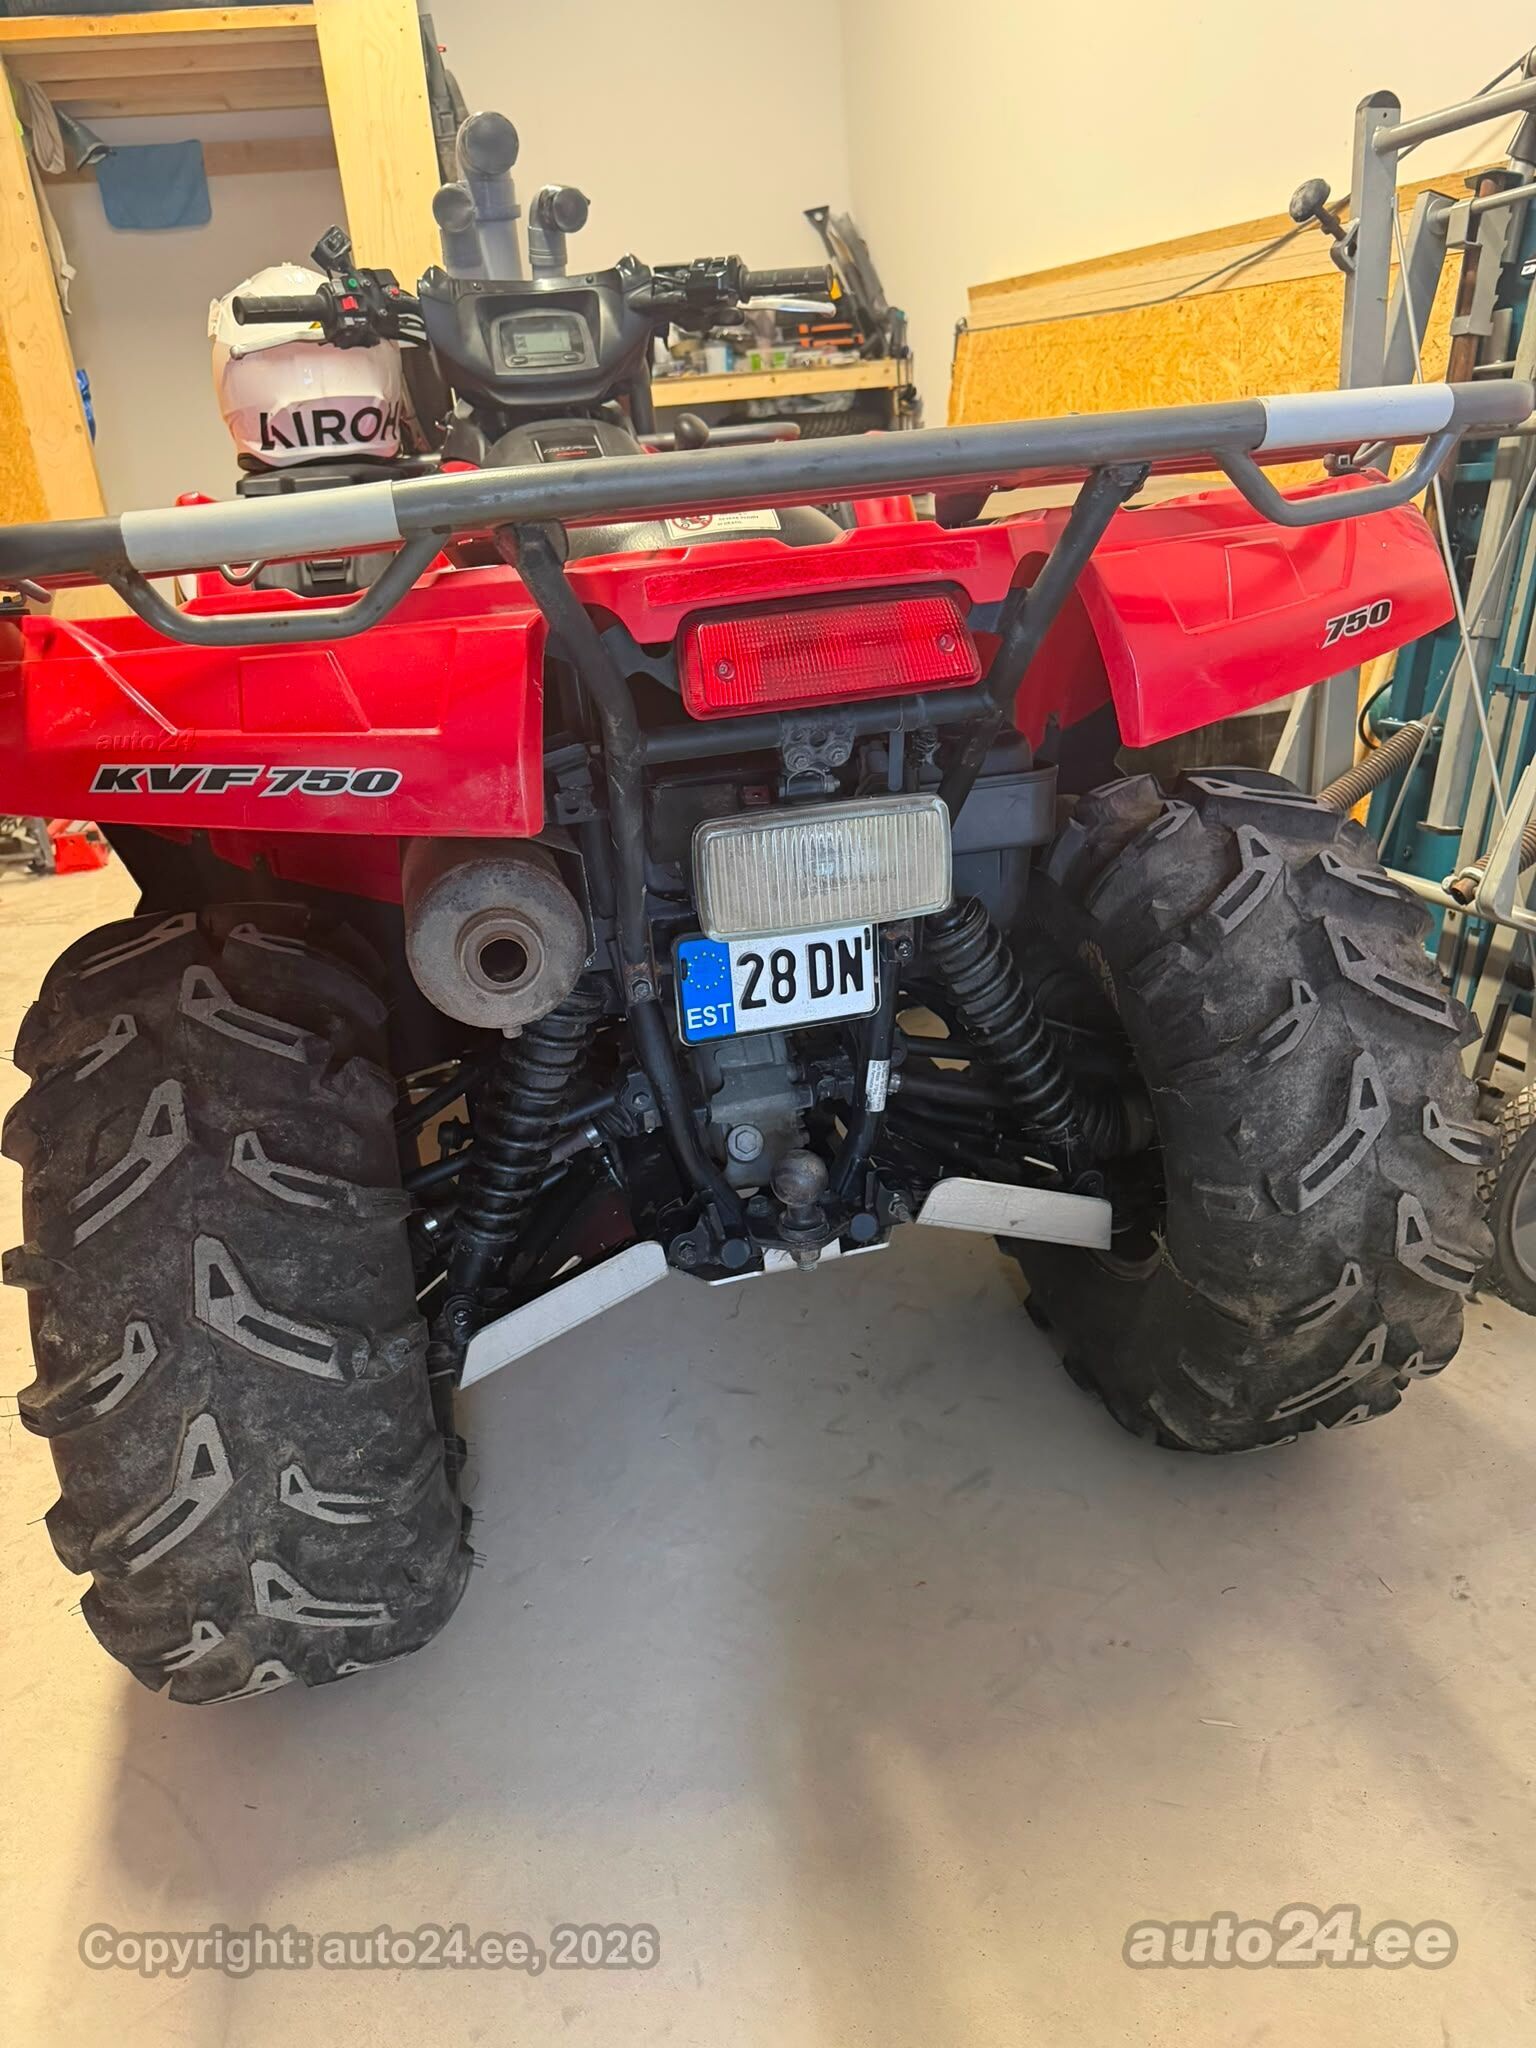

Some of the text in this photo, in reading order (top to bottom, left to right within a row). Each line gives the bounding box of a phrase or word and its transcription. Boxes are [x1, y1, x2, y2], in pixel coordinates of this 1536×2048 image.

[1321, 598, 1393, 649] 750
[89, 763, 404, 798] KVF 750
[686, 1002, 732, 1030] EST
